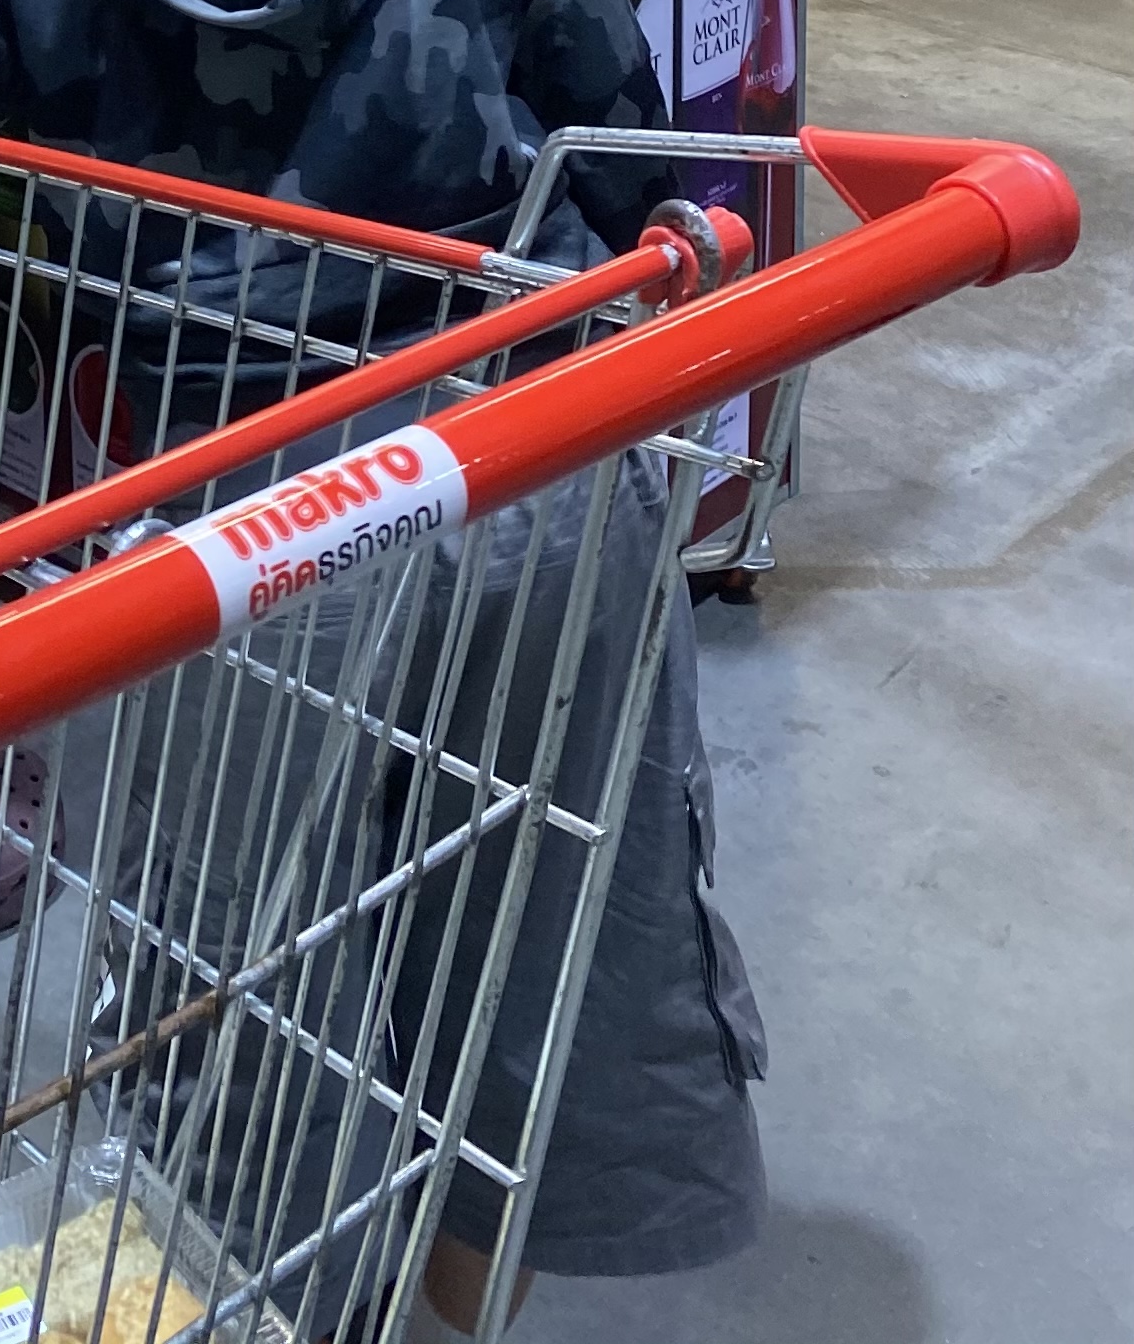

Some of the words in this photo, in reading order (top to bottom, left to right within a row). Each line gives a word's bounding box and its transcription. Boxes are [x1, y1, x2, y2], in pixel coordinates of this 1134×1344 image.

[692, 27, 741, 66] CLAIR
[693, 4, 741, 44] MONT
[210, 443, 424, 561] makro
[248, 499, 443, 620] คู่คิดธุรกิจคุณ
